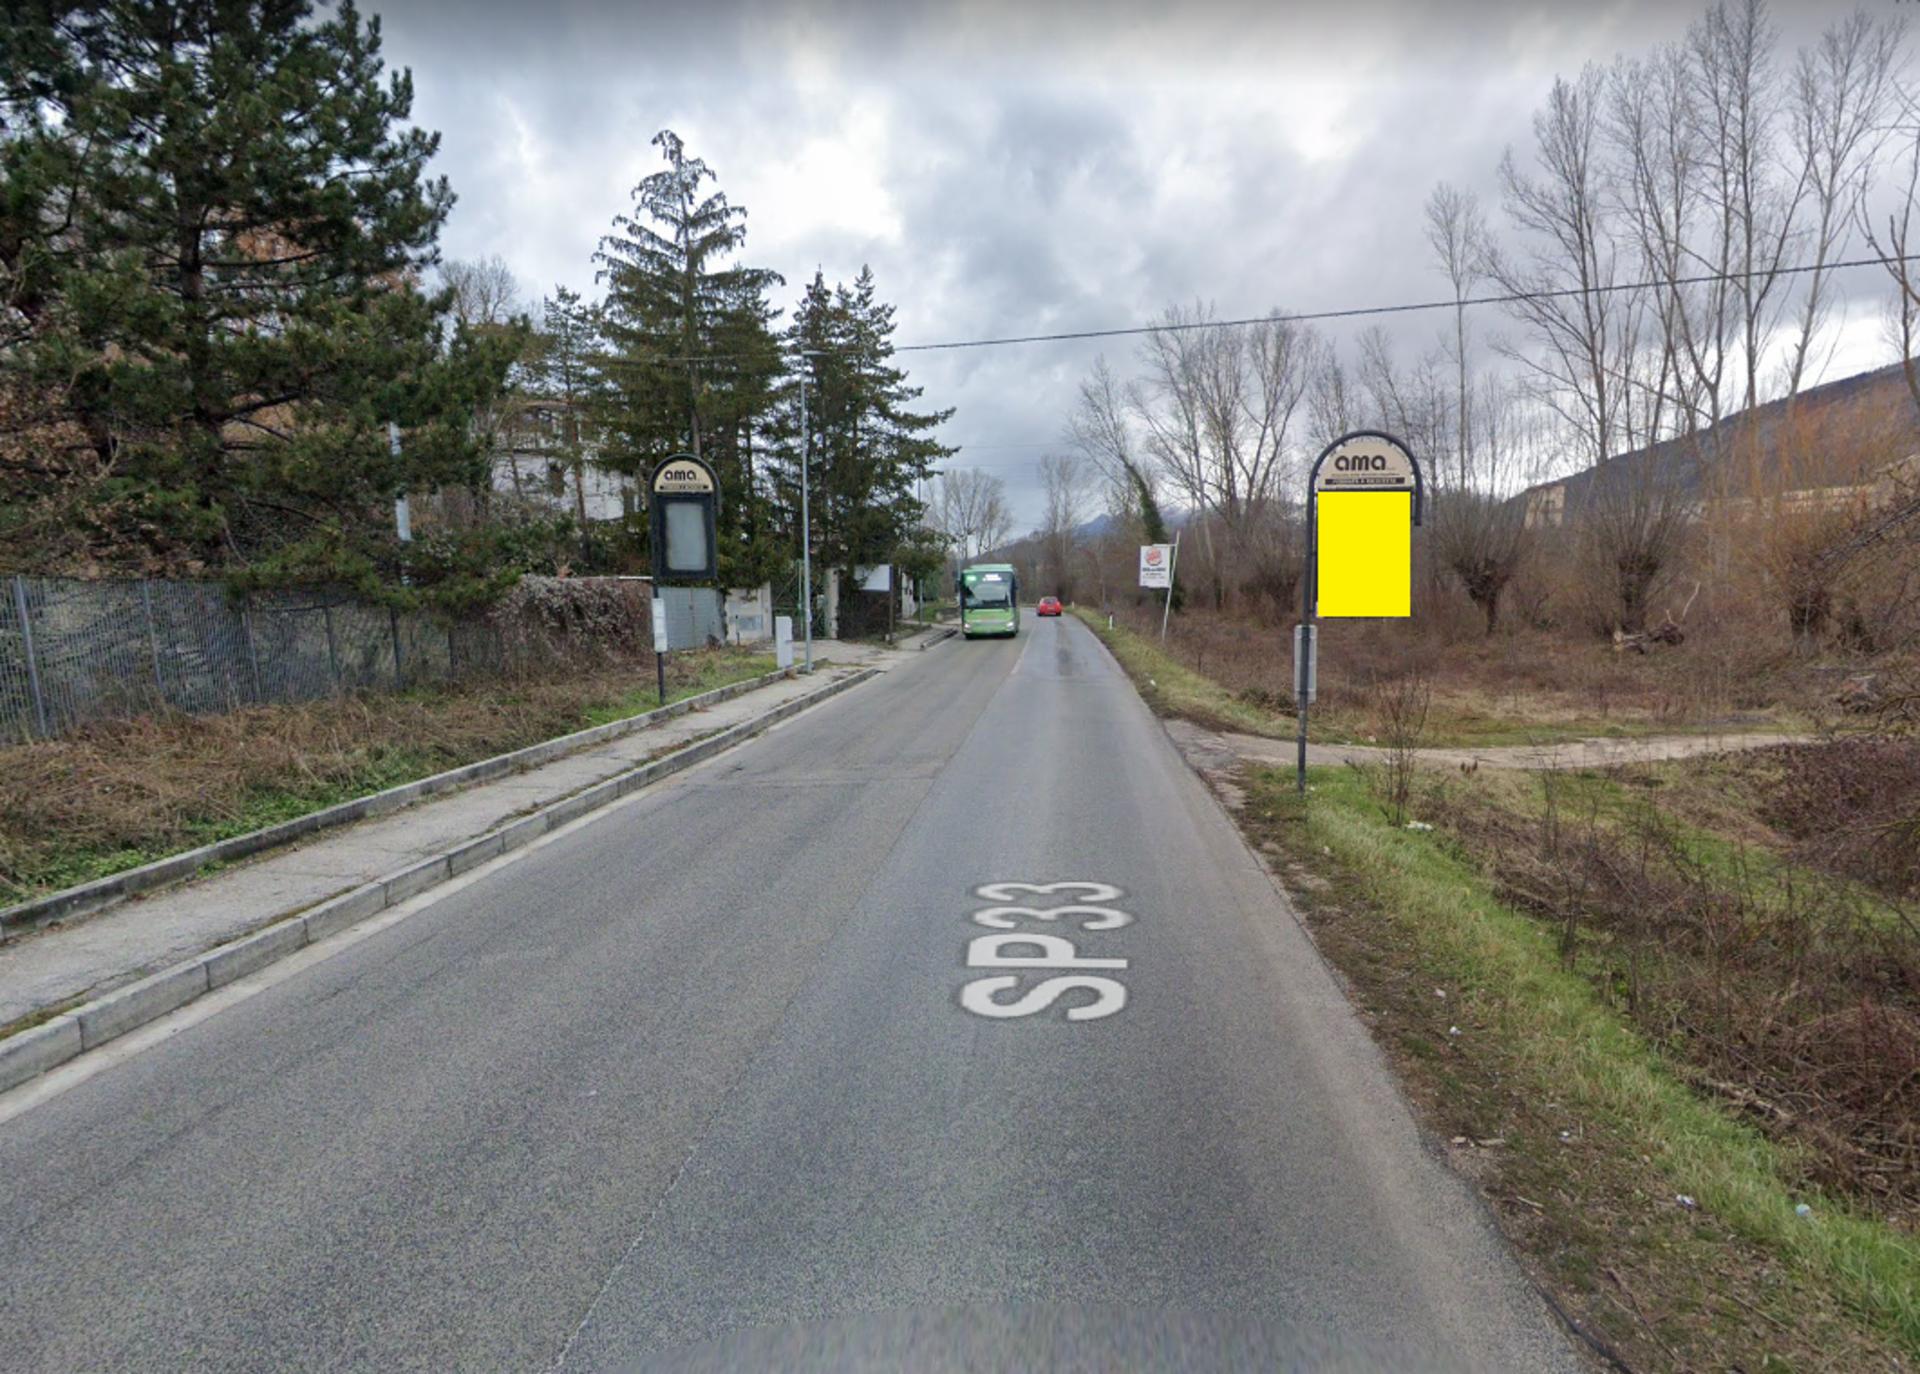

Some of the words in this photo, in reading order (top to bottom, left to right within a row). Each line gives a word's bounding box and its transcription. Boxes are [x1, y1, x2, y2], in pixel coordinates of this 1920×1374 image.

[1334, 455, 1387, 471] ama
[664, 469, 697, 481] ama
[961, 881, 1131, 1020] SP33
